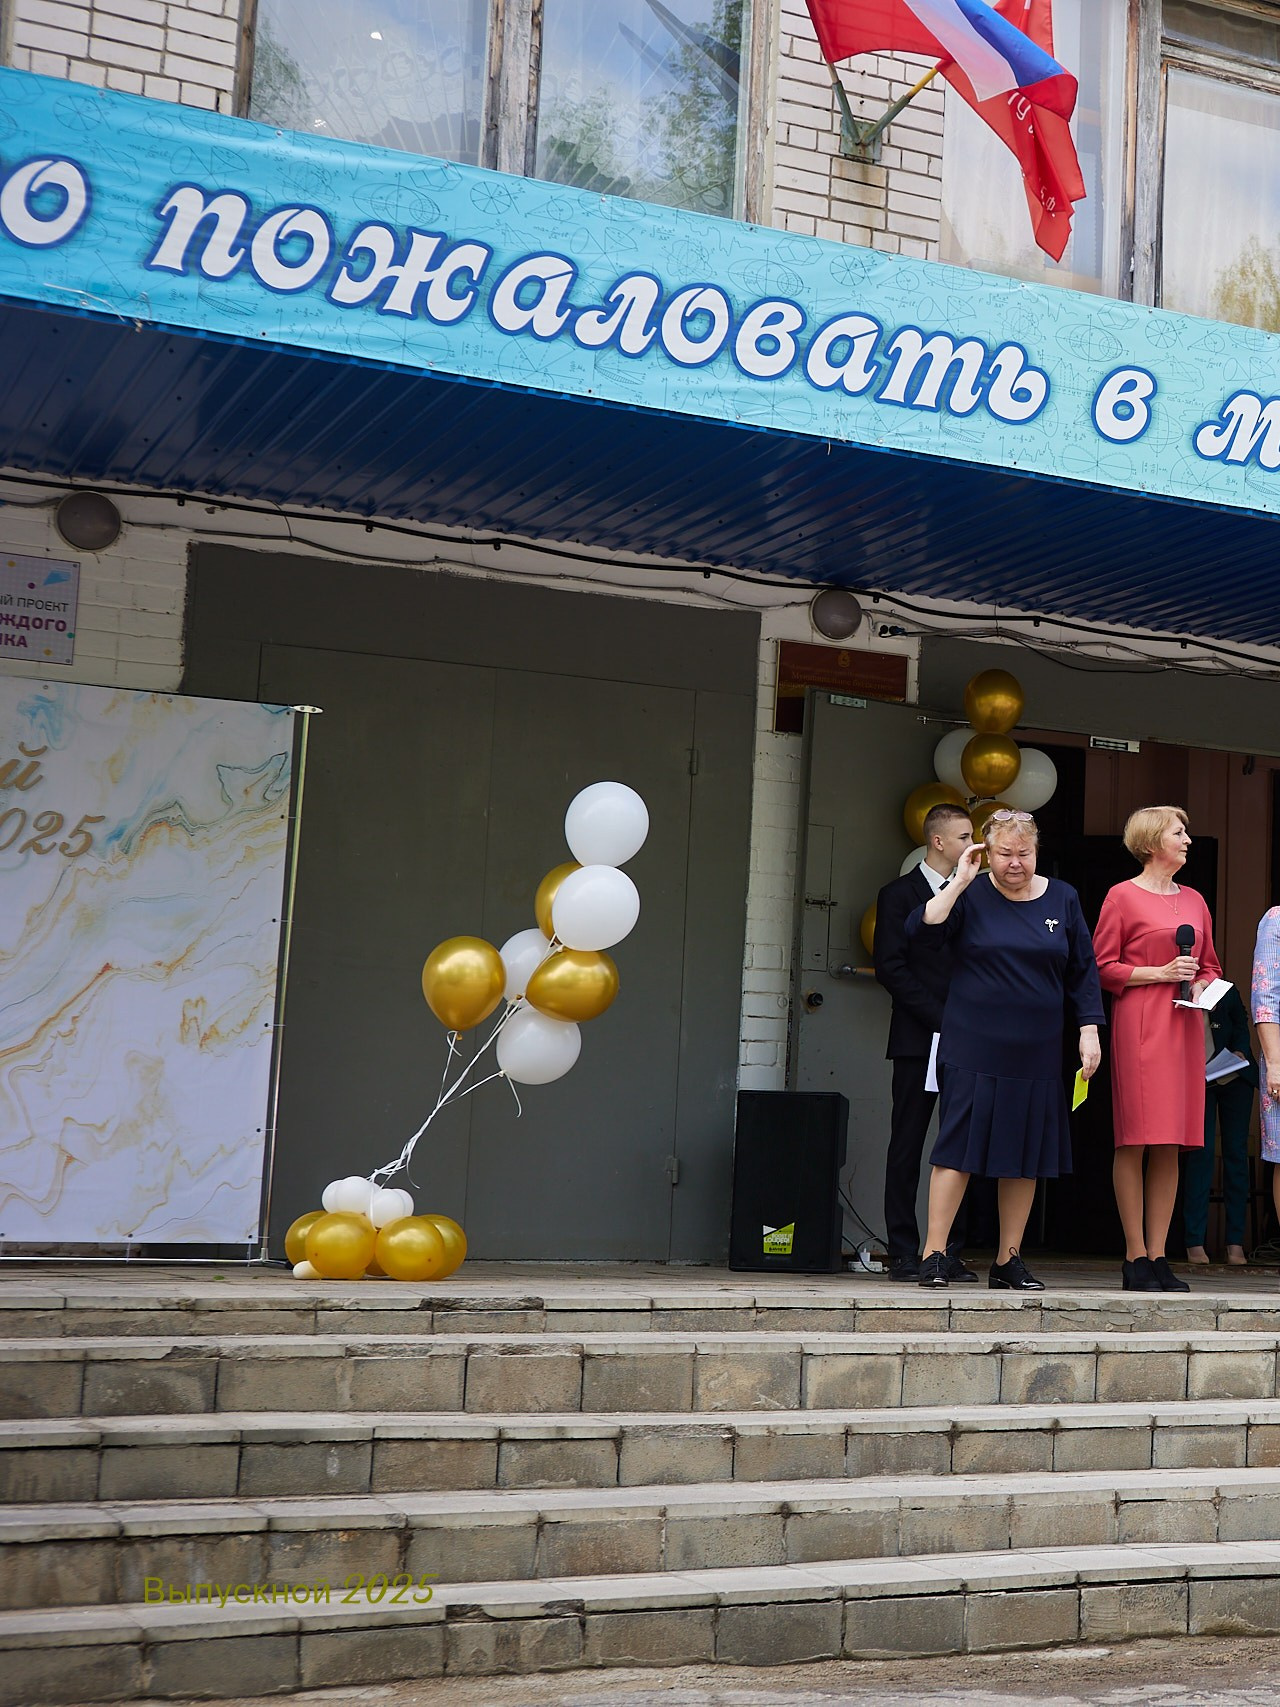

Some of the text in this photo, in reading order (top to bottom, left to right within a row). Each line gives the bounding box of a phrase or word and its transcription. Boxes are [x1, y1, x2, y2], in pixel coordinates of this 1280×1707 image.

[144, 182, 1050, 425] пожаловать
[1091, 365, 1158, 444] в
[17, 597, 69, 612] ПРОЕКТ
